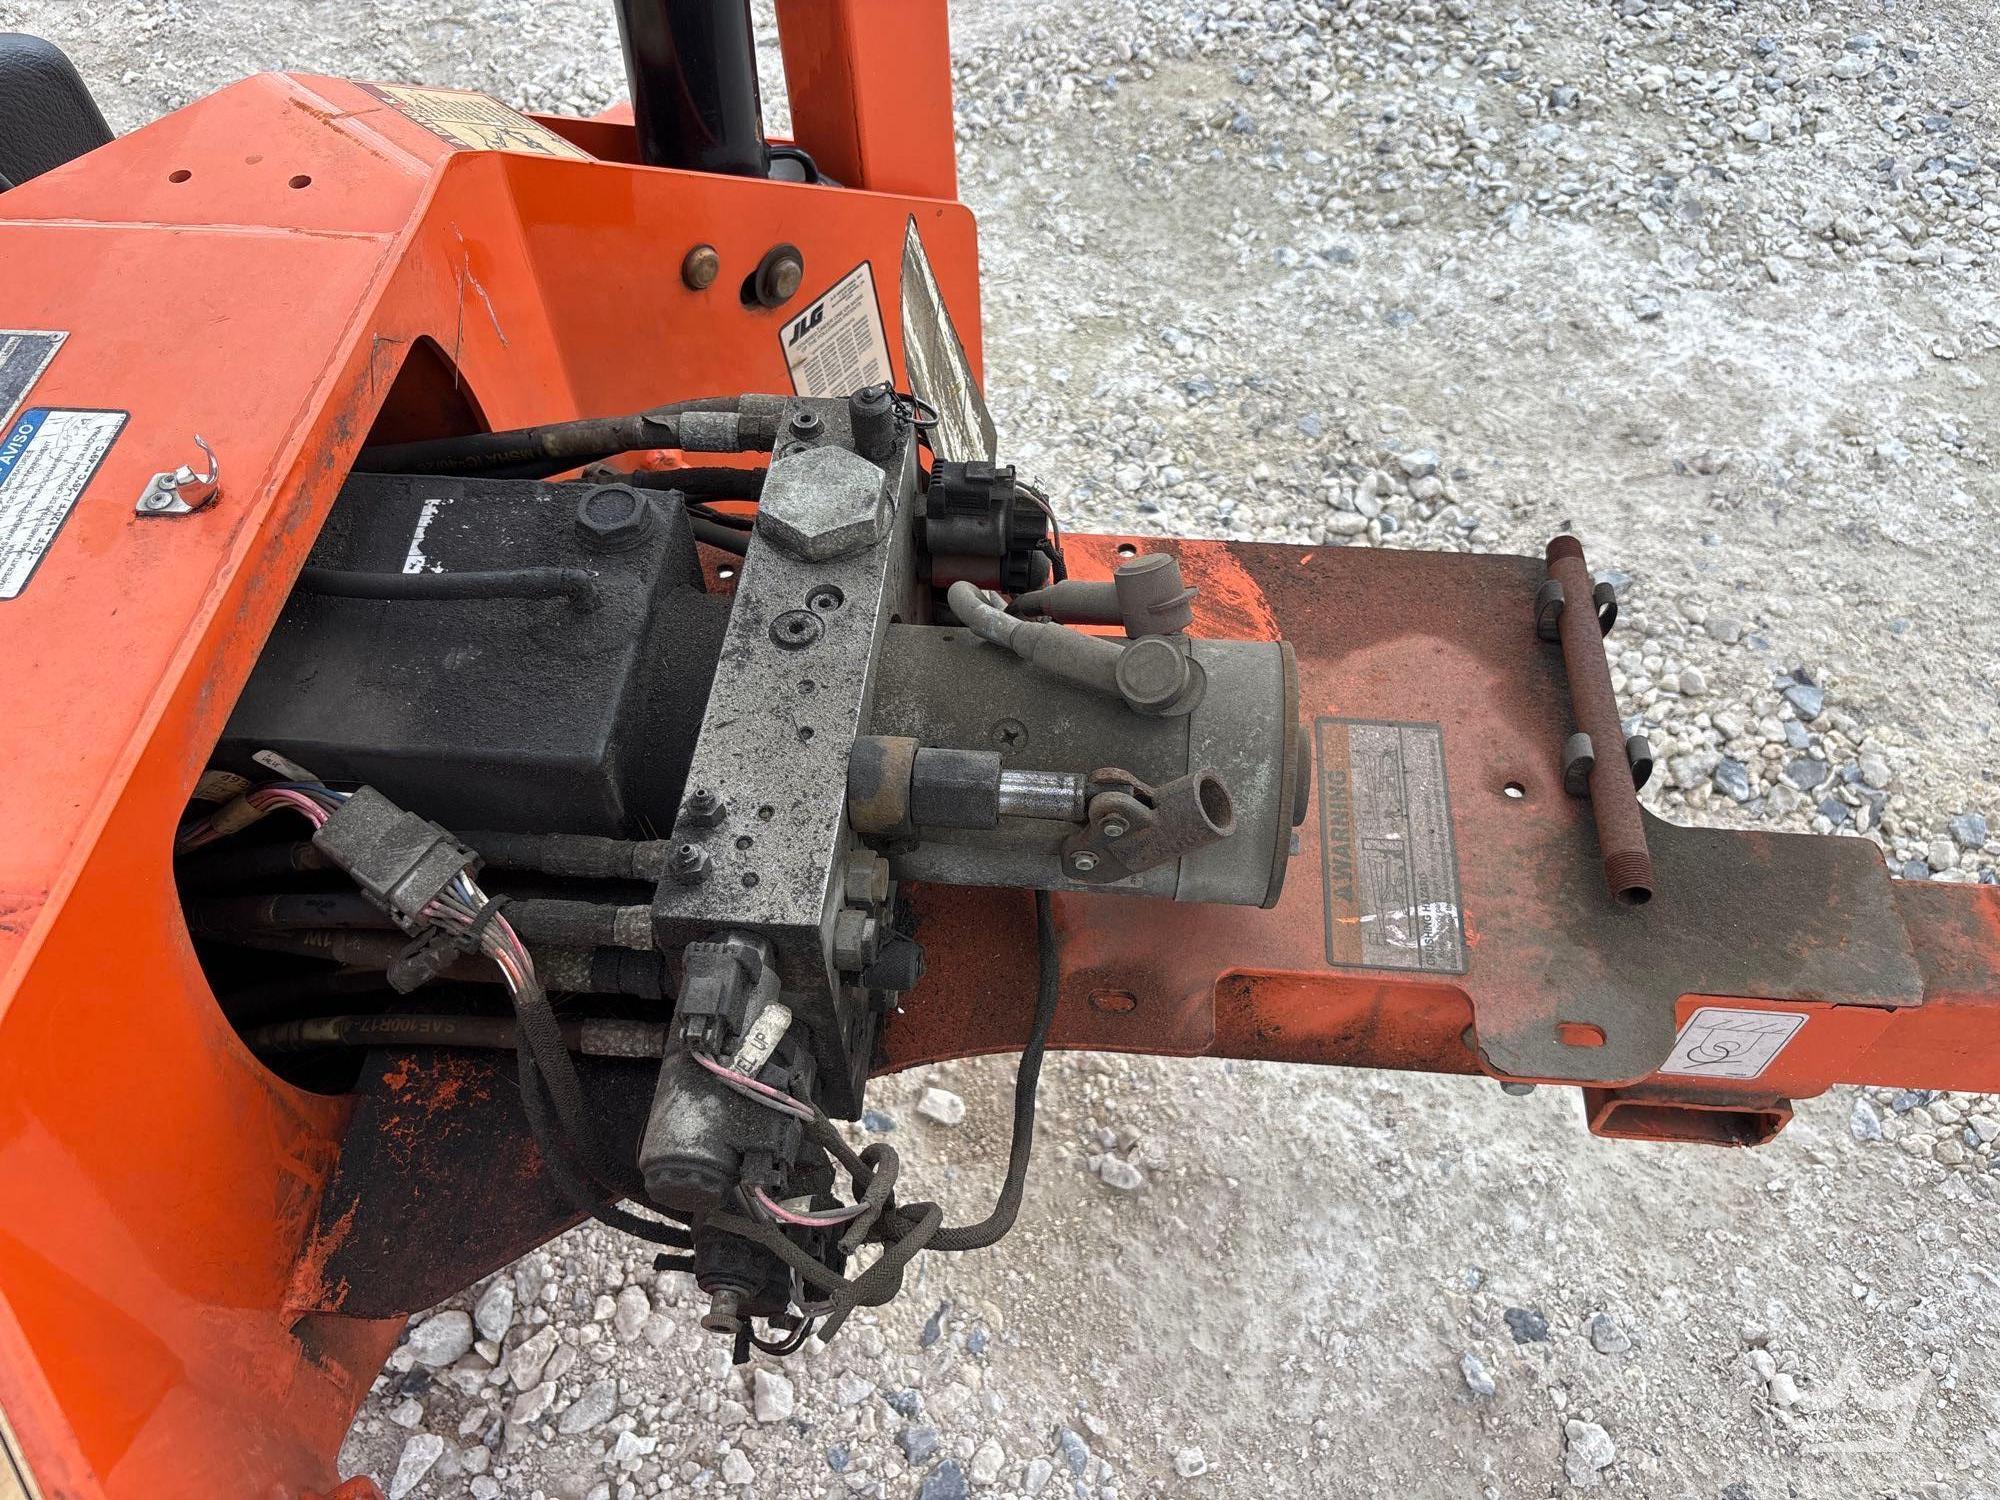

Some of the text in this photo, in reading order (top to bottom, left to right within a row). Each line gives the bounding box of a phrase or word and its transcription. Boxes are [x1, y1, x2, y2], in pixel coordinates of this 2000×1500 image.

[379, 97, 452, 136] DANGR
[789, 302, 824, 347] JLG
[0, 424, 33, 465] AVISO
[1328, 770, 1351, 884] WARNING
[1422, 914, 1436, 966] CRUSHING
